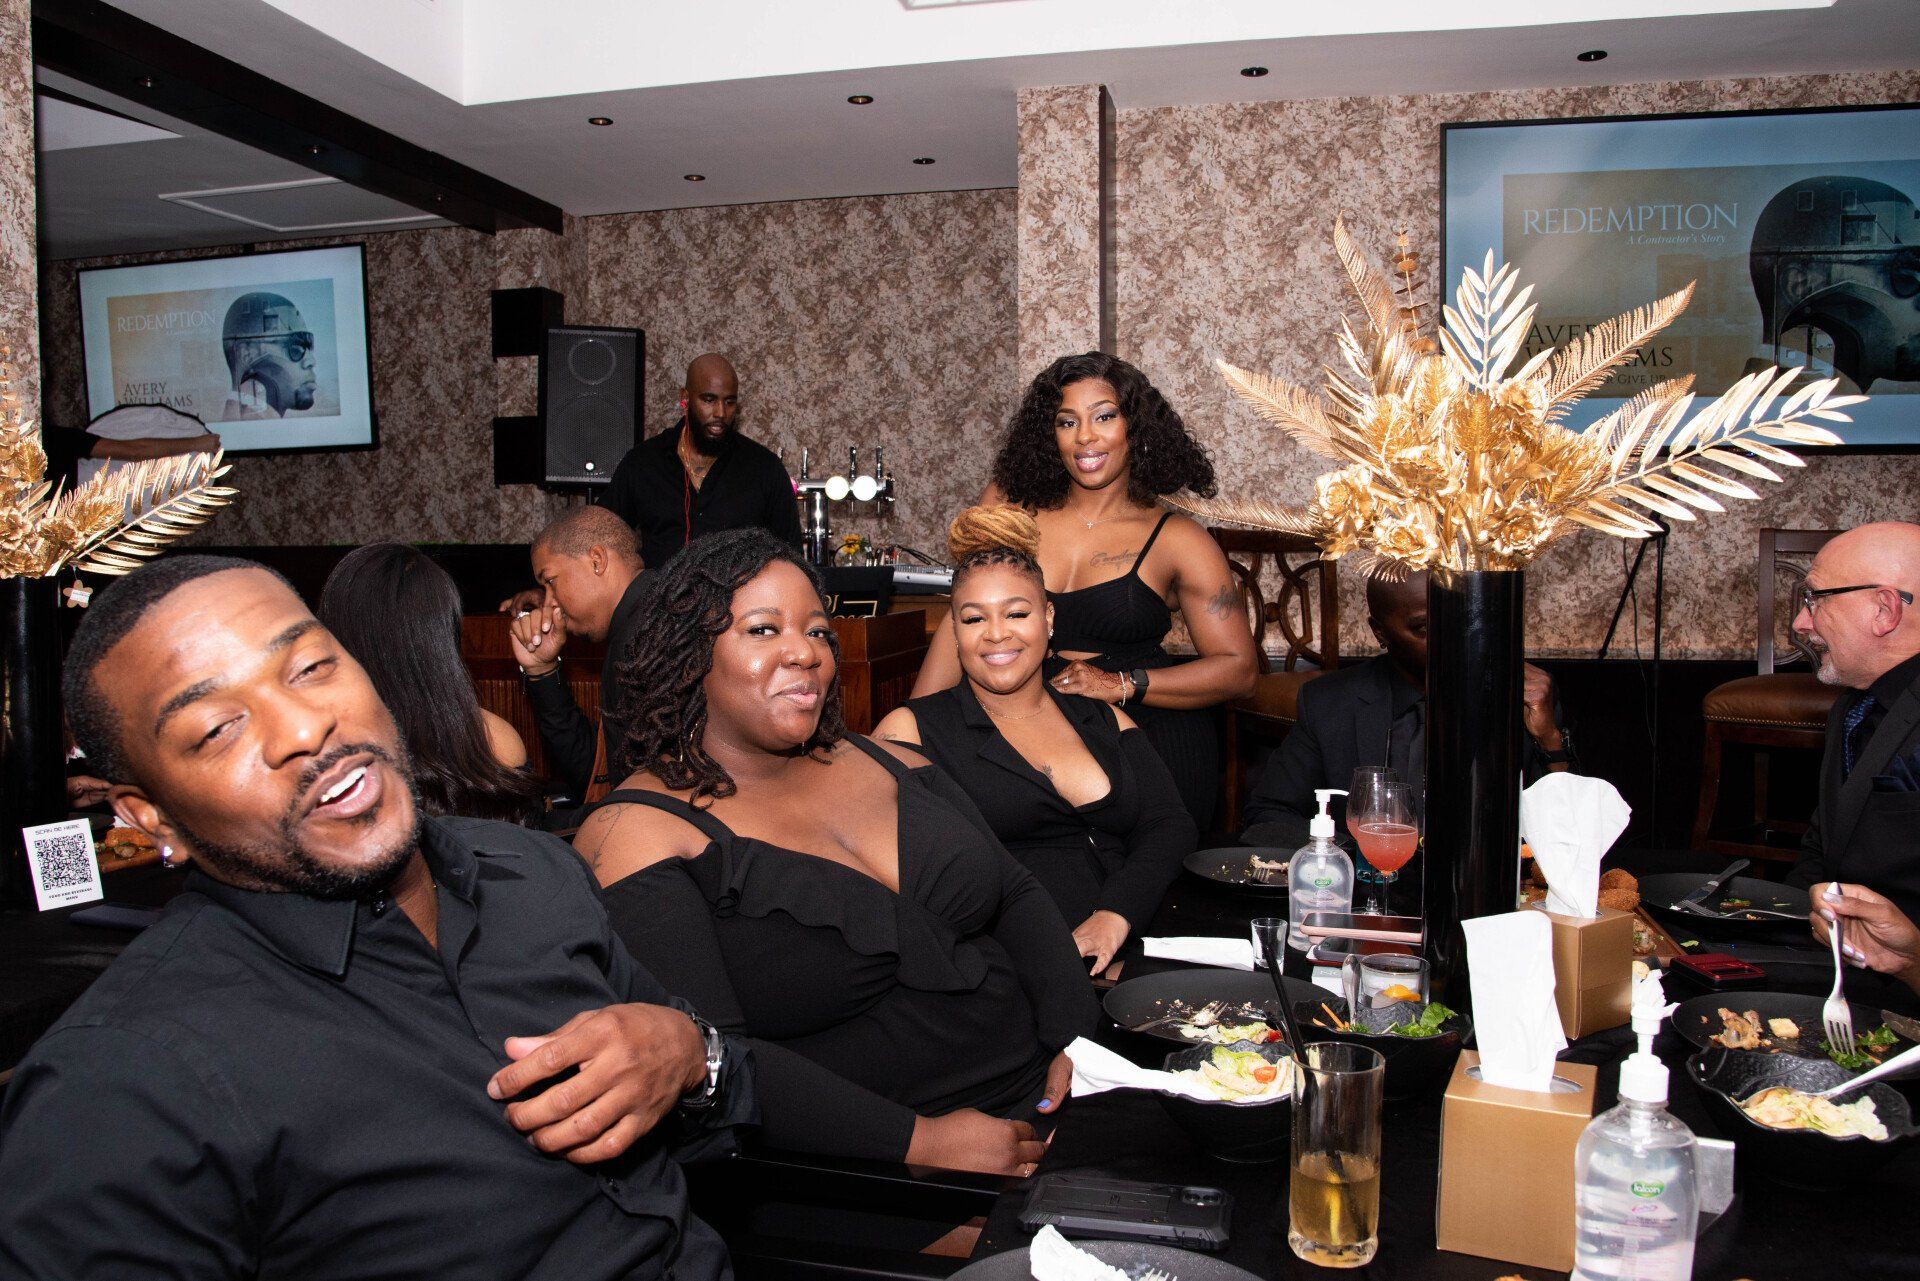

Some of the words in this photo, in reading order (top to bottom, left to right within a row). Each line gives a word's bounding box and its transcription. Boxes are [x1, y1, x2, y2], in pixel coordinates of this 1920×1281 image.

[1523, 203, 1738, 235] REDEMPTION
[1627, 235, 1634, 245] A
[1638, 232, 1698, 245] Contractor's
[1701, 232, 1725, 246] Story
[117, 310, 216, 332] REDEMPTION
[1617, 374, 1646, 385] GIVE
[123, 382, 167, 396] AVERY
[1633, 1183, 1661, 1195] falcon
